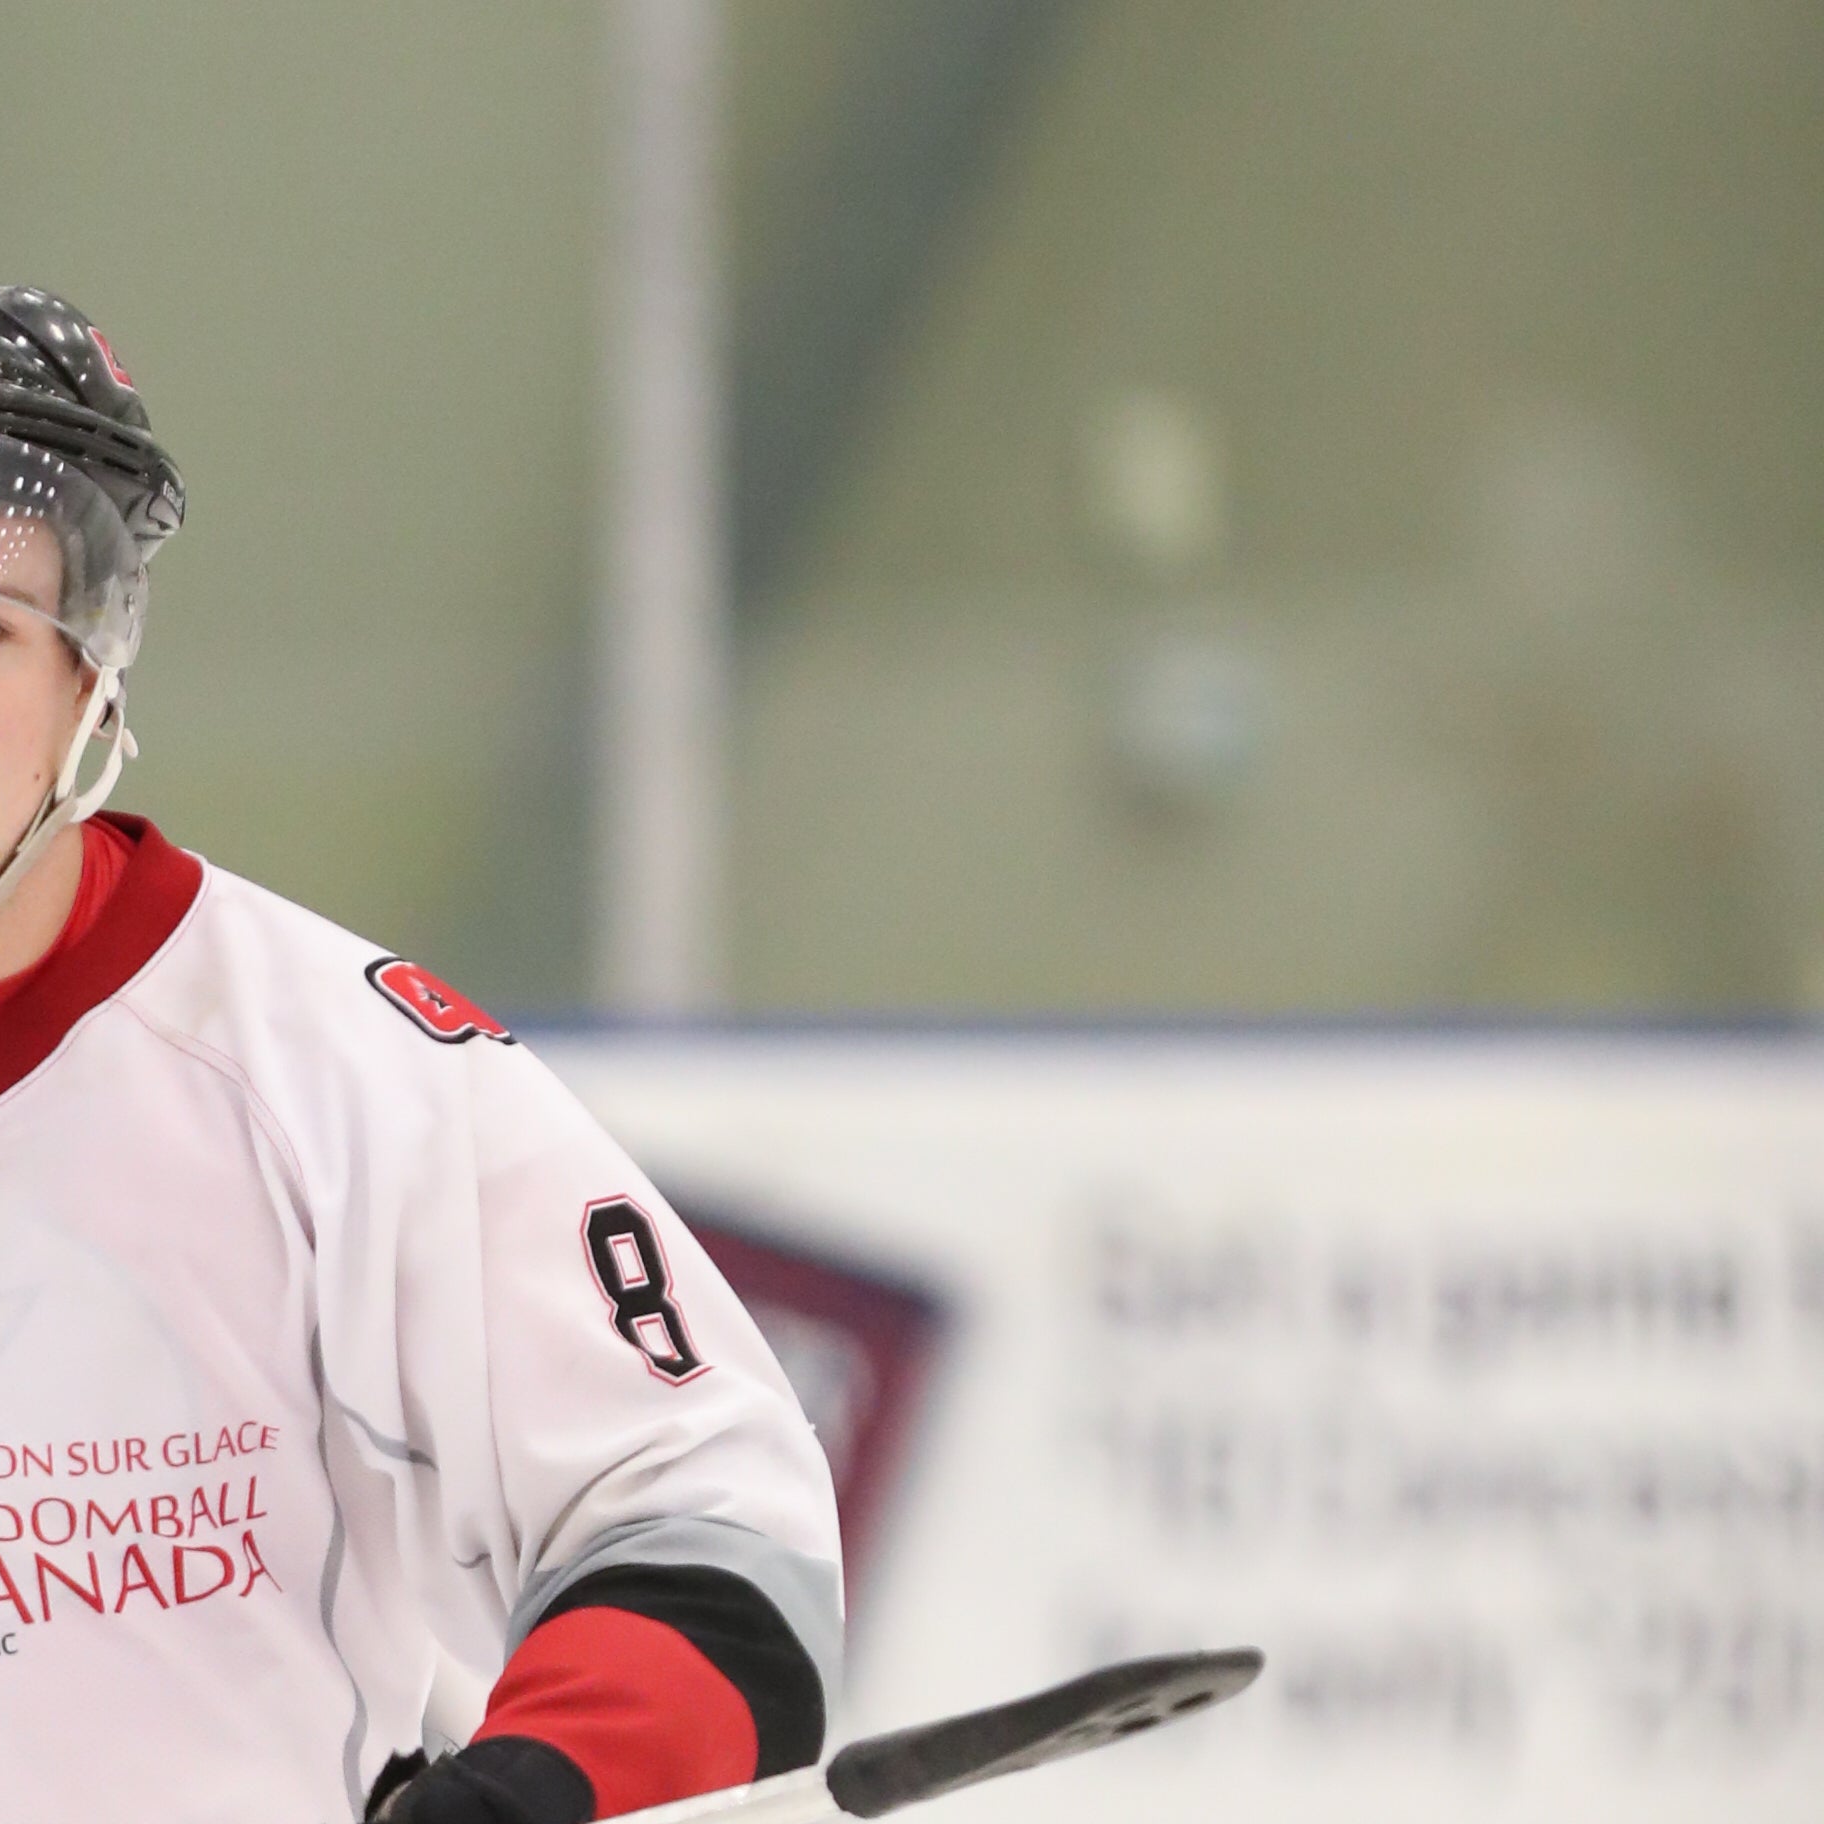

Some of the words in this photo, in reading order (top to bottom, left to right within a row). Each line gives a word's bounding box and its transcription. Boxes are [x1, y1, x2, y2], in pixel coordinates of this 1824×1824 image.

[580, 1193, 716, 1388] 8
[67, 1438, 152, 1477] SUR
[162, 1420, 280, 1468] GLACE
